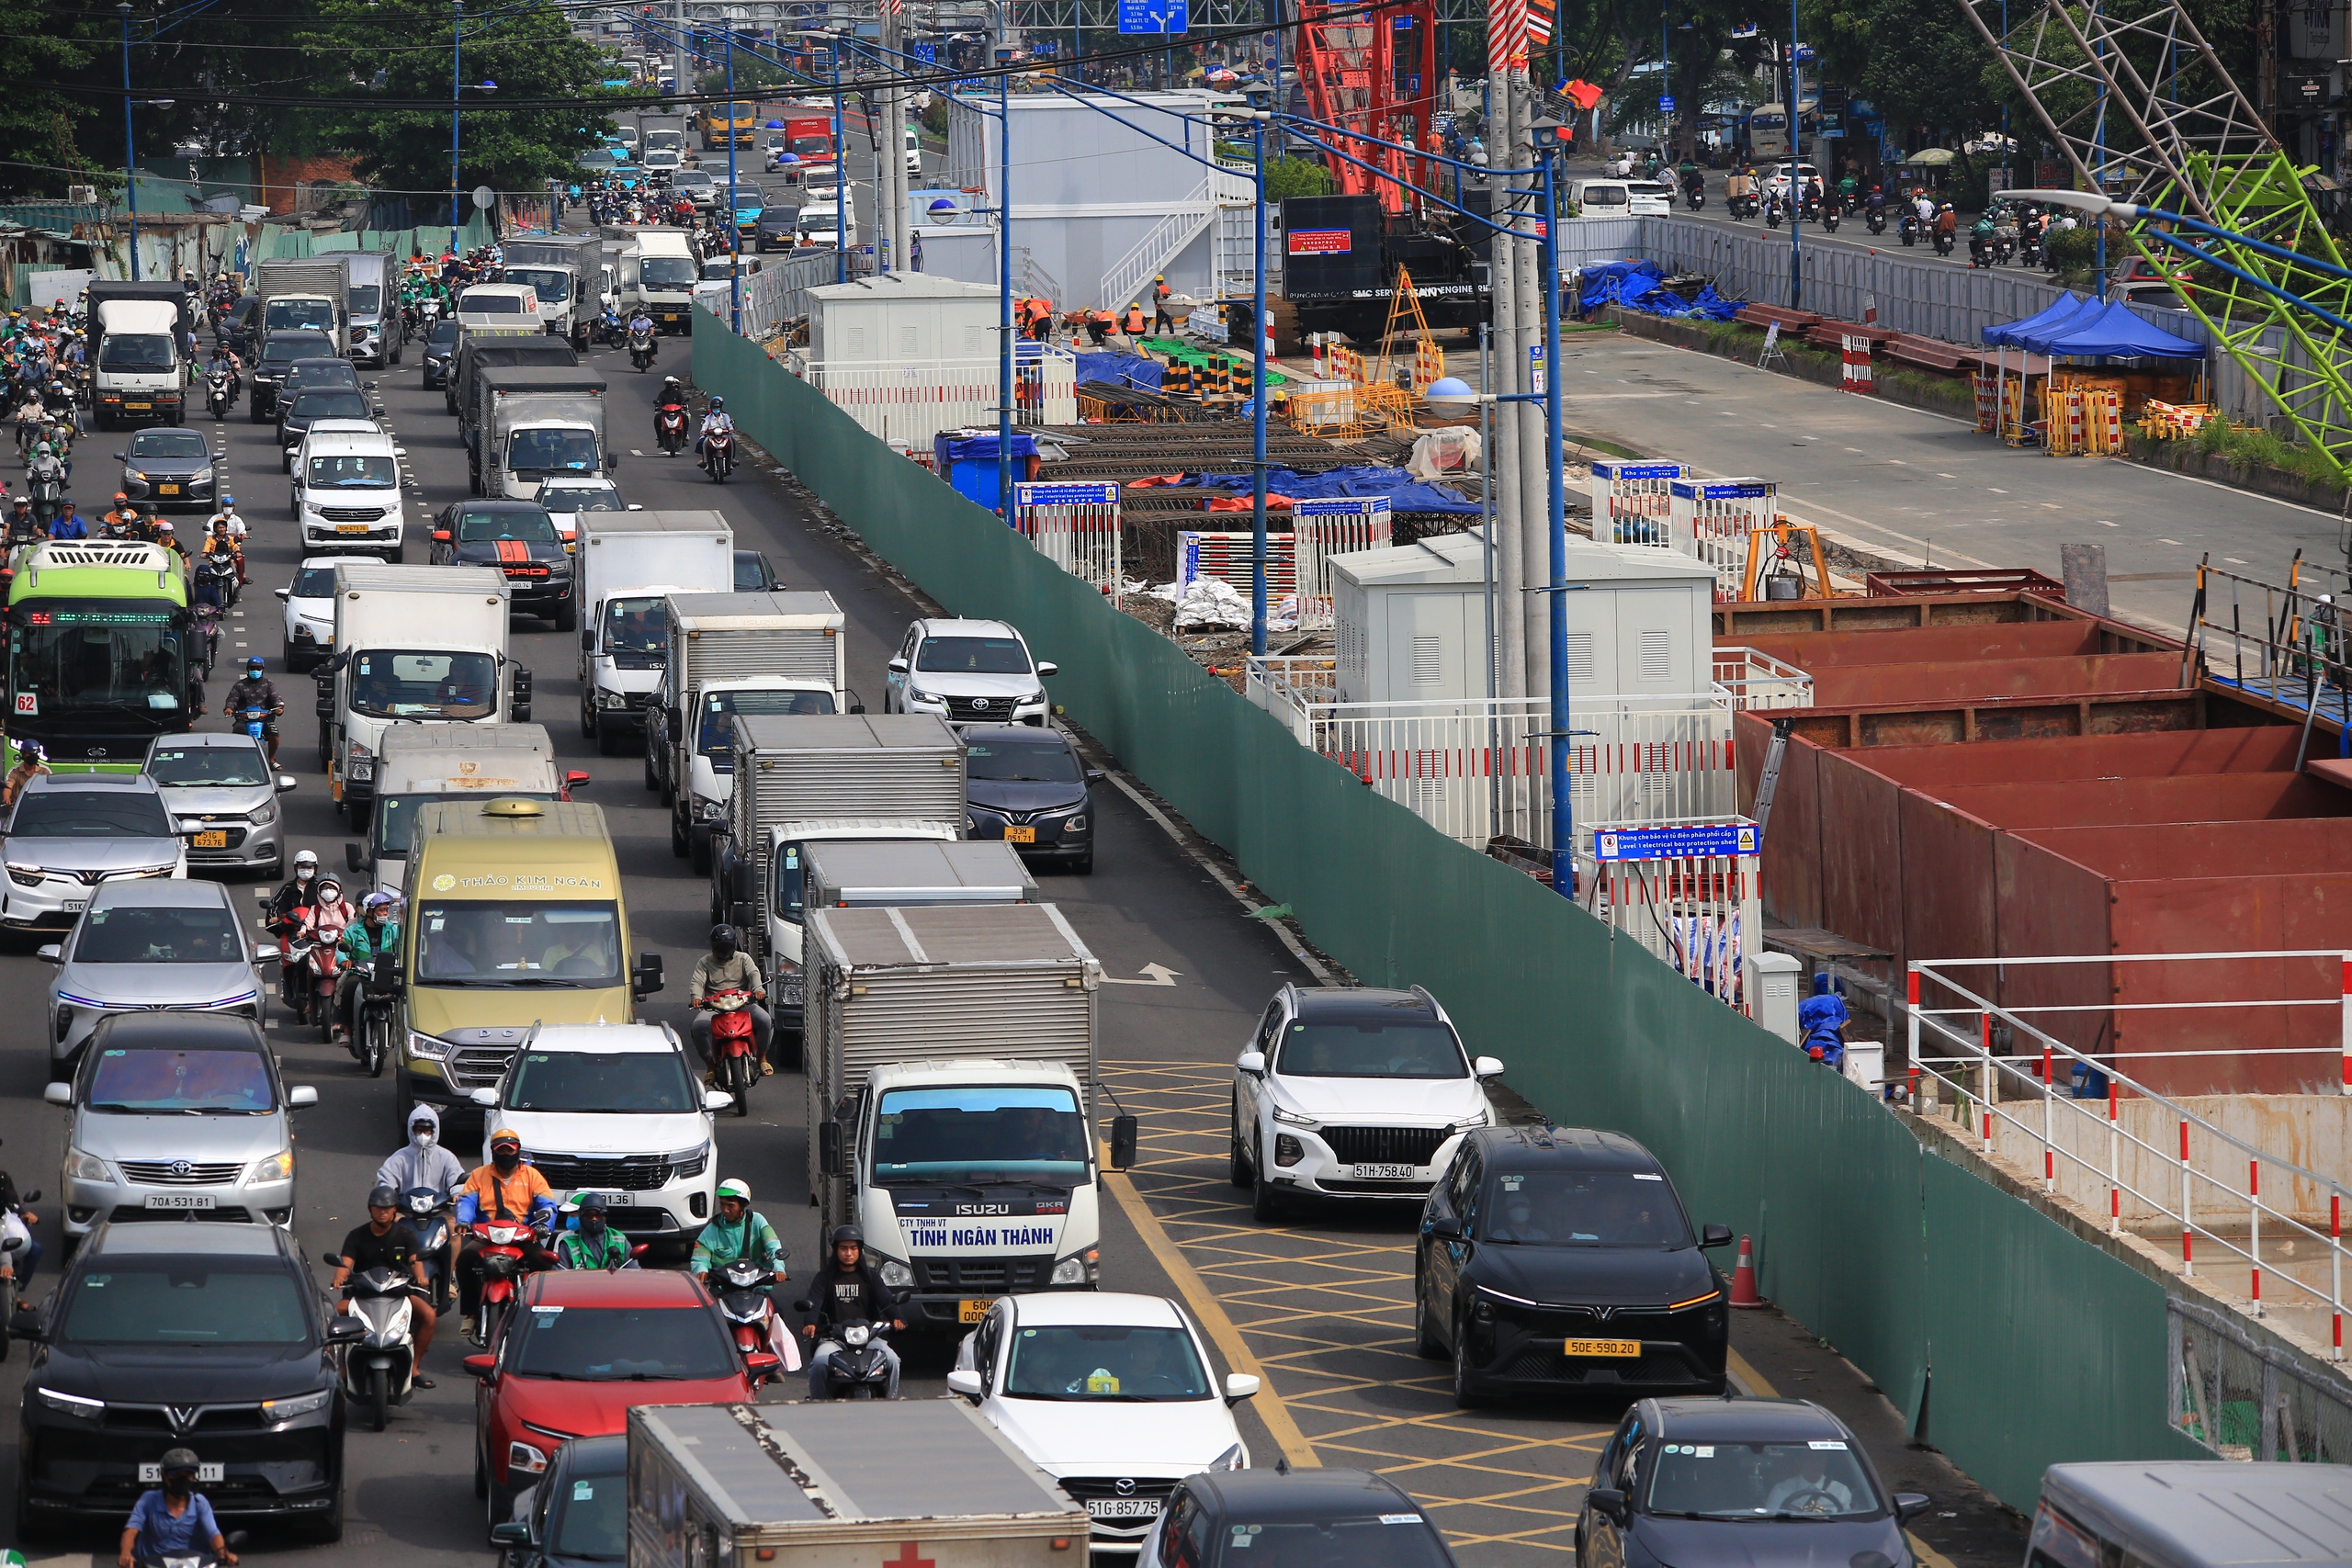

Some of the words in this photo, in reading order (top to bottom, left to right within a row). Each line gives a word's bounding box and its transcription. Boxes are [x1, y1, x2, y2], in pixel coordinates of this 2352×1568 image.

[17, 696, 34, 711] 62
[460, 874, 508, 888] THẢO
[515, 876, 547, 885] KIM
[555, 876, 601, 889] NGÂN
[1356, 1165, 1412, 1177] 51H-758.40
[152, 1197, 208, 1206] 70A-531.81
[956, 1205, 1009, 1215] ISUZU
[900, 1218, 915, 1227] CTY
[916, 1218, 936, 1227] TNHH
[910, 1227, 947, 1246] TÍNH
[952, 1226, 996, 1246] NGÂN
[1001, 1224, 1053, 1244] THÀNH
[1572, 1342, 1634, 1353] 50E-590.20
[1089, 1501, 1158, 1515] 51G-857.75
